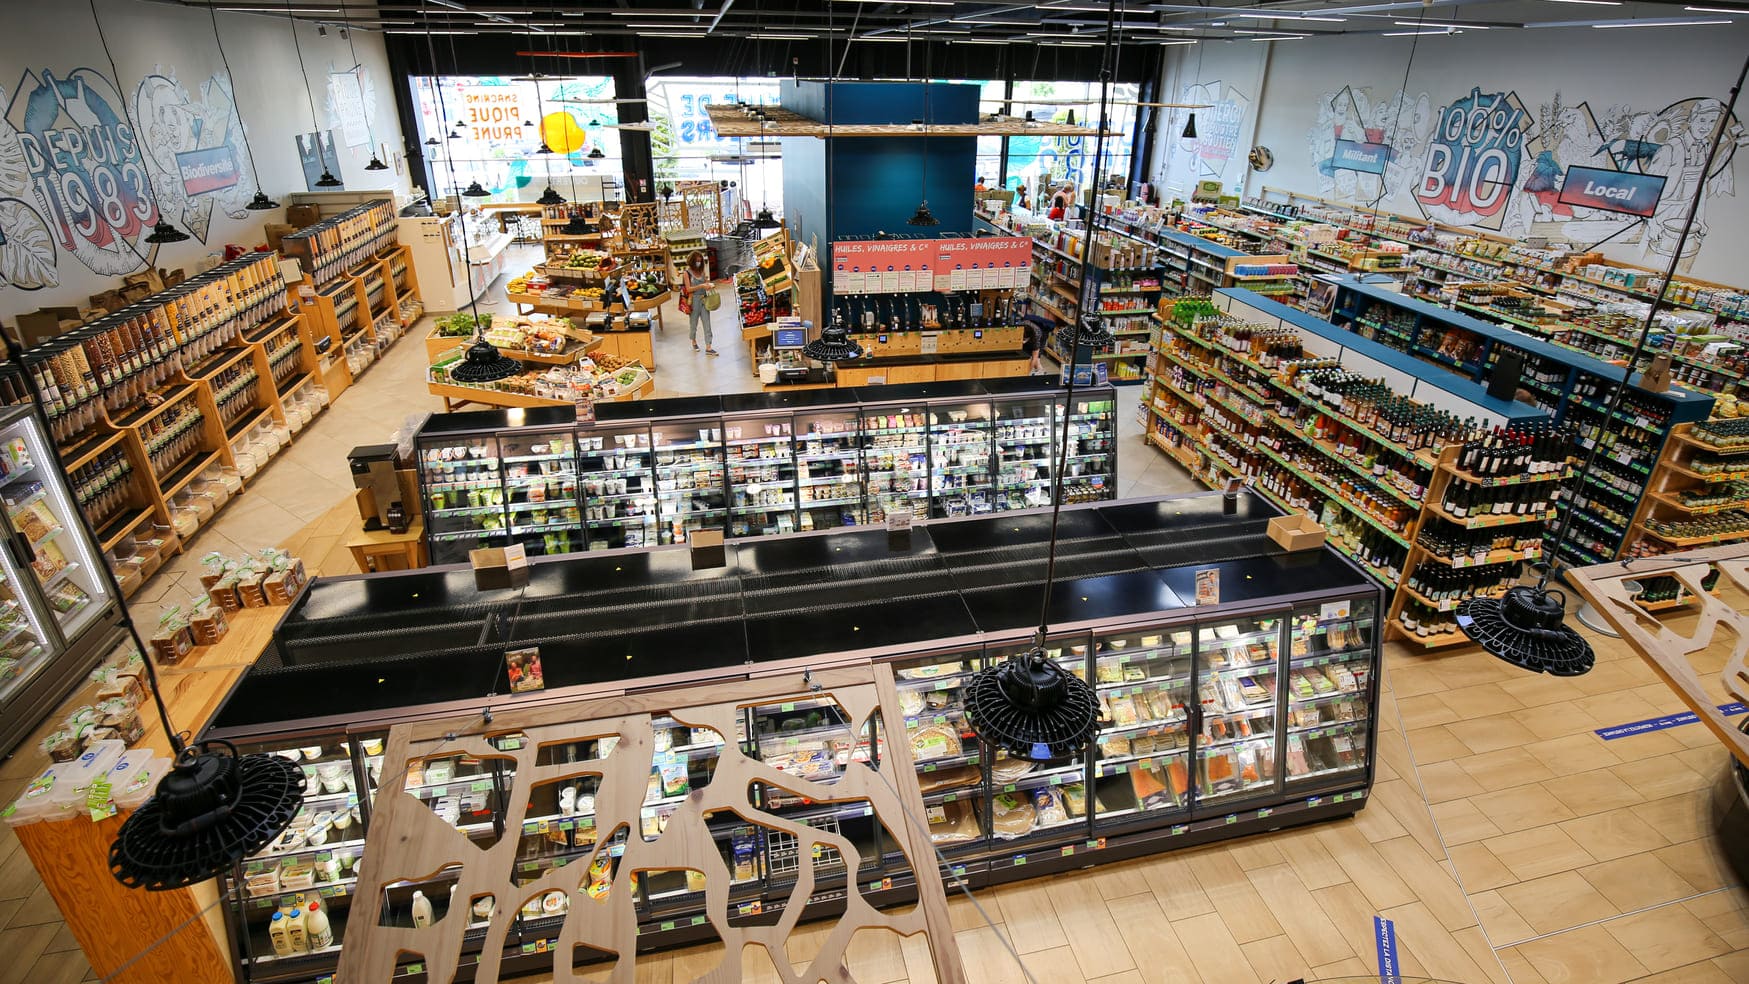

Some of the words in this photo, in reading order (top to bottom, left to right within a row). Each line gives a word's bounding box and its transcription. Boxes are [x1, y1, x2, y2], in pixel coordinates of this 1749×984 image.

[16, 123, 137, 174] DEPUIS
[1433, 107, 1520, 148] 100%
[1342, 149, 1378, 163] Militant
[1419, 143, 1508, 208] BIO
[32, 162, 152, 244] 1983
[1583, 180, 1637, 201] Local
